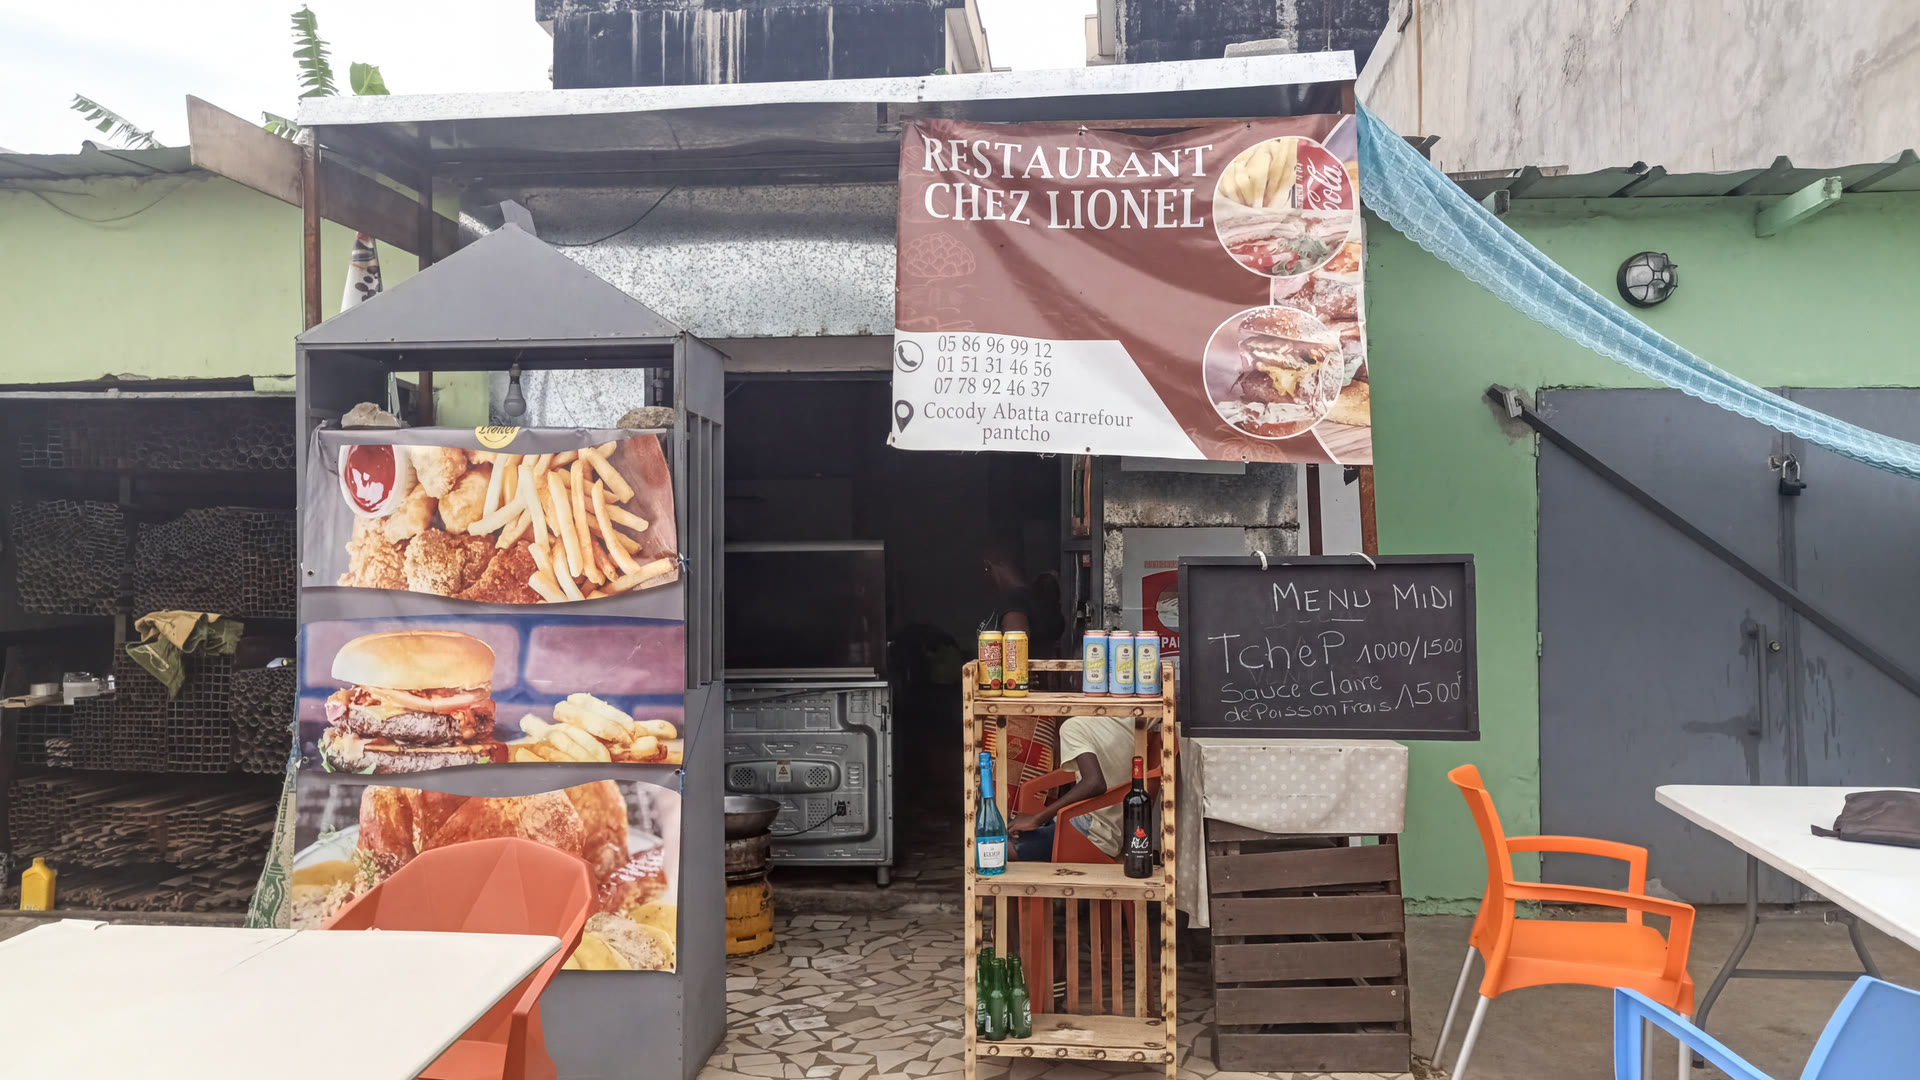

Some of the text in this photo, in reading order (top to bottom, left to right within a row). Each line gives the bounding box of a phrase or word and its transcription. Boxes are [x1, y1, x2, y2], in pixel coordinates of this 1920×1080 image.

[922, 134, 1213, 179] RESTAURANT
[924, 182, 1204, 230] CHEZ LIONEL
[938, 335, 1052, 358] 05 86 96 99 12
[937, 356, 1052, 378] 01 51 31 46 56
[934, 377, 1050, 398] 07 78 92 46 37
[924, 402, 1134, 428] Cocody Abatta carrefour
[982, 424, 1050, 445] pantcho
[1272, 582, 1371, 612] MENU
[1161, 636, 1180, 649] PA
[1355, 635, 1463, 665] 1000/1500
[1220, 682, 1301, 704] Sauce
